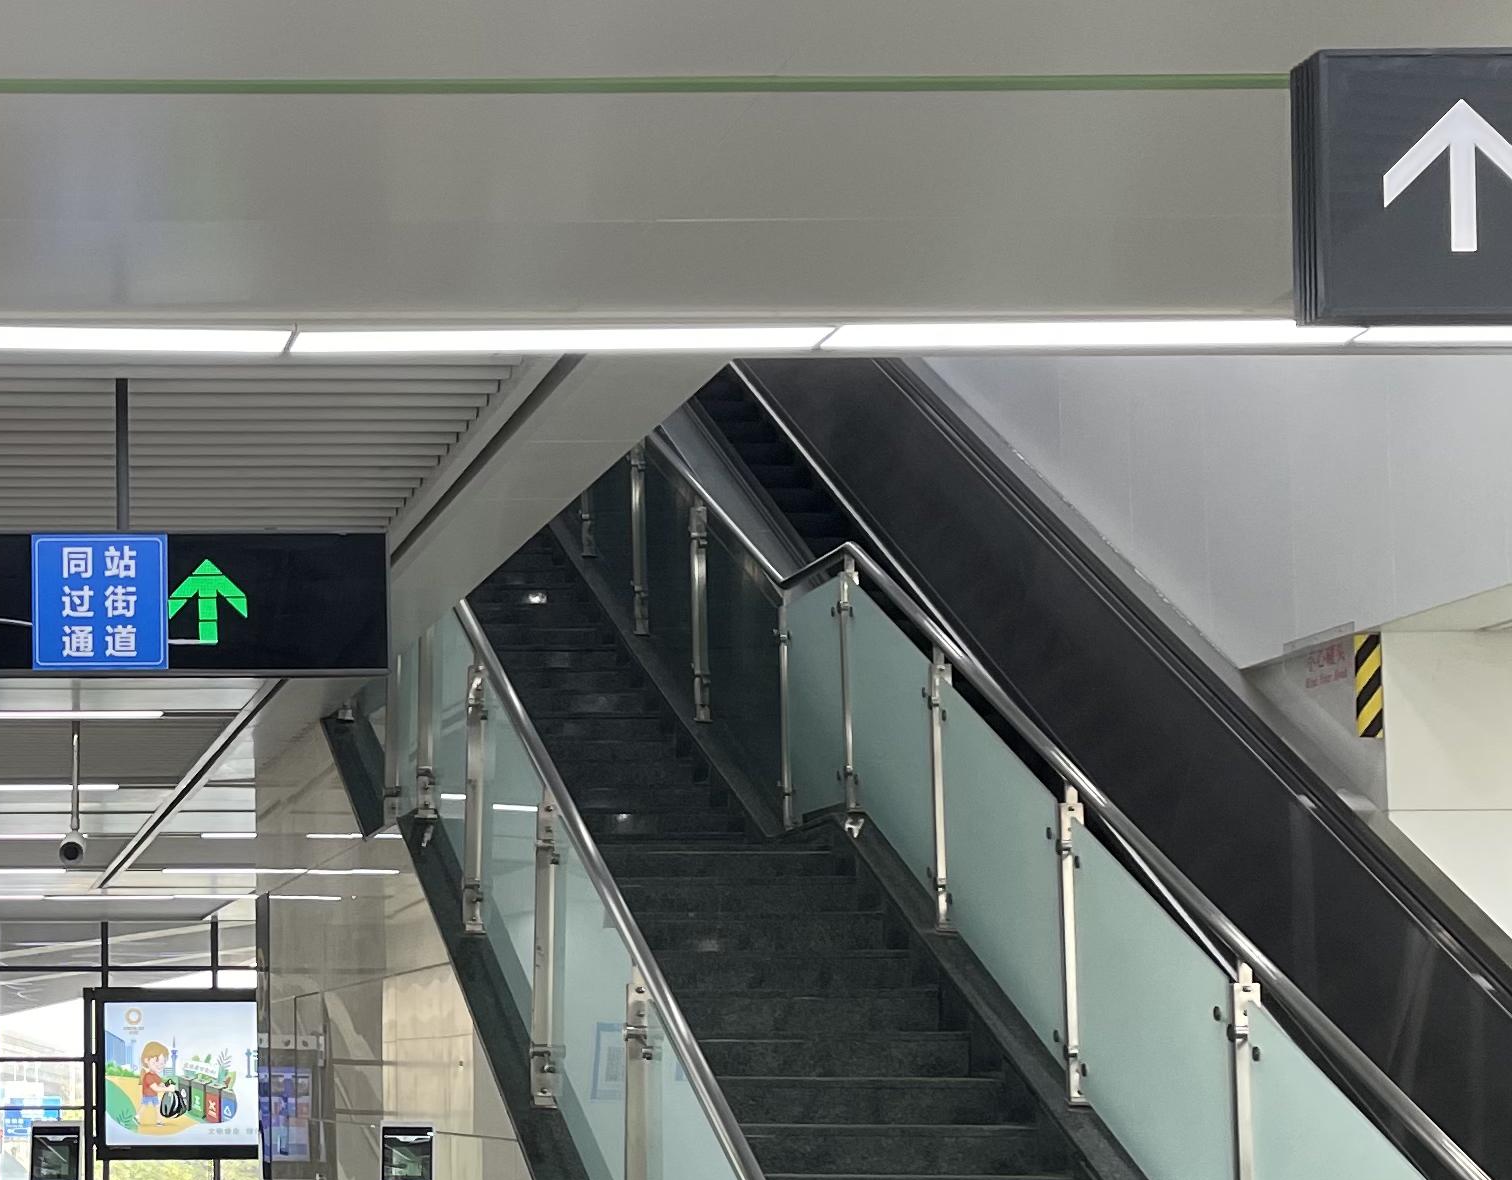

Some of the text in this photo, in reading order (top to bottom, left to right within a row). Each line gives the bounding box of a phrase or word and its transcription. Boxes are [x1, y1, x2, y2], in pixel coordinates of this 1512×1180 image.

[61, 545, 138, 579] 同站
[61, 585, 138, 618] 过街
[61, 624, 138, 657] 通道
